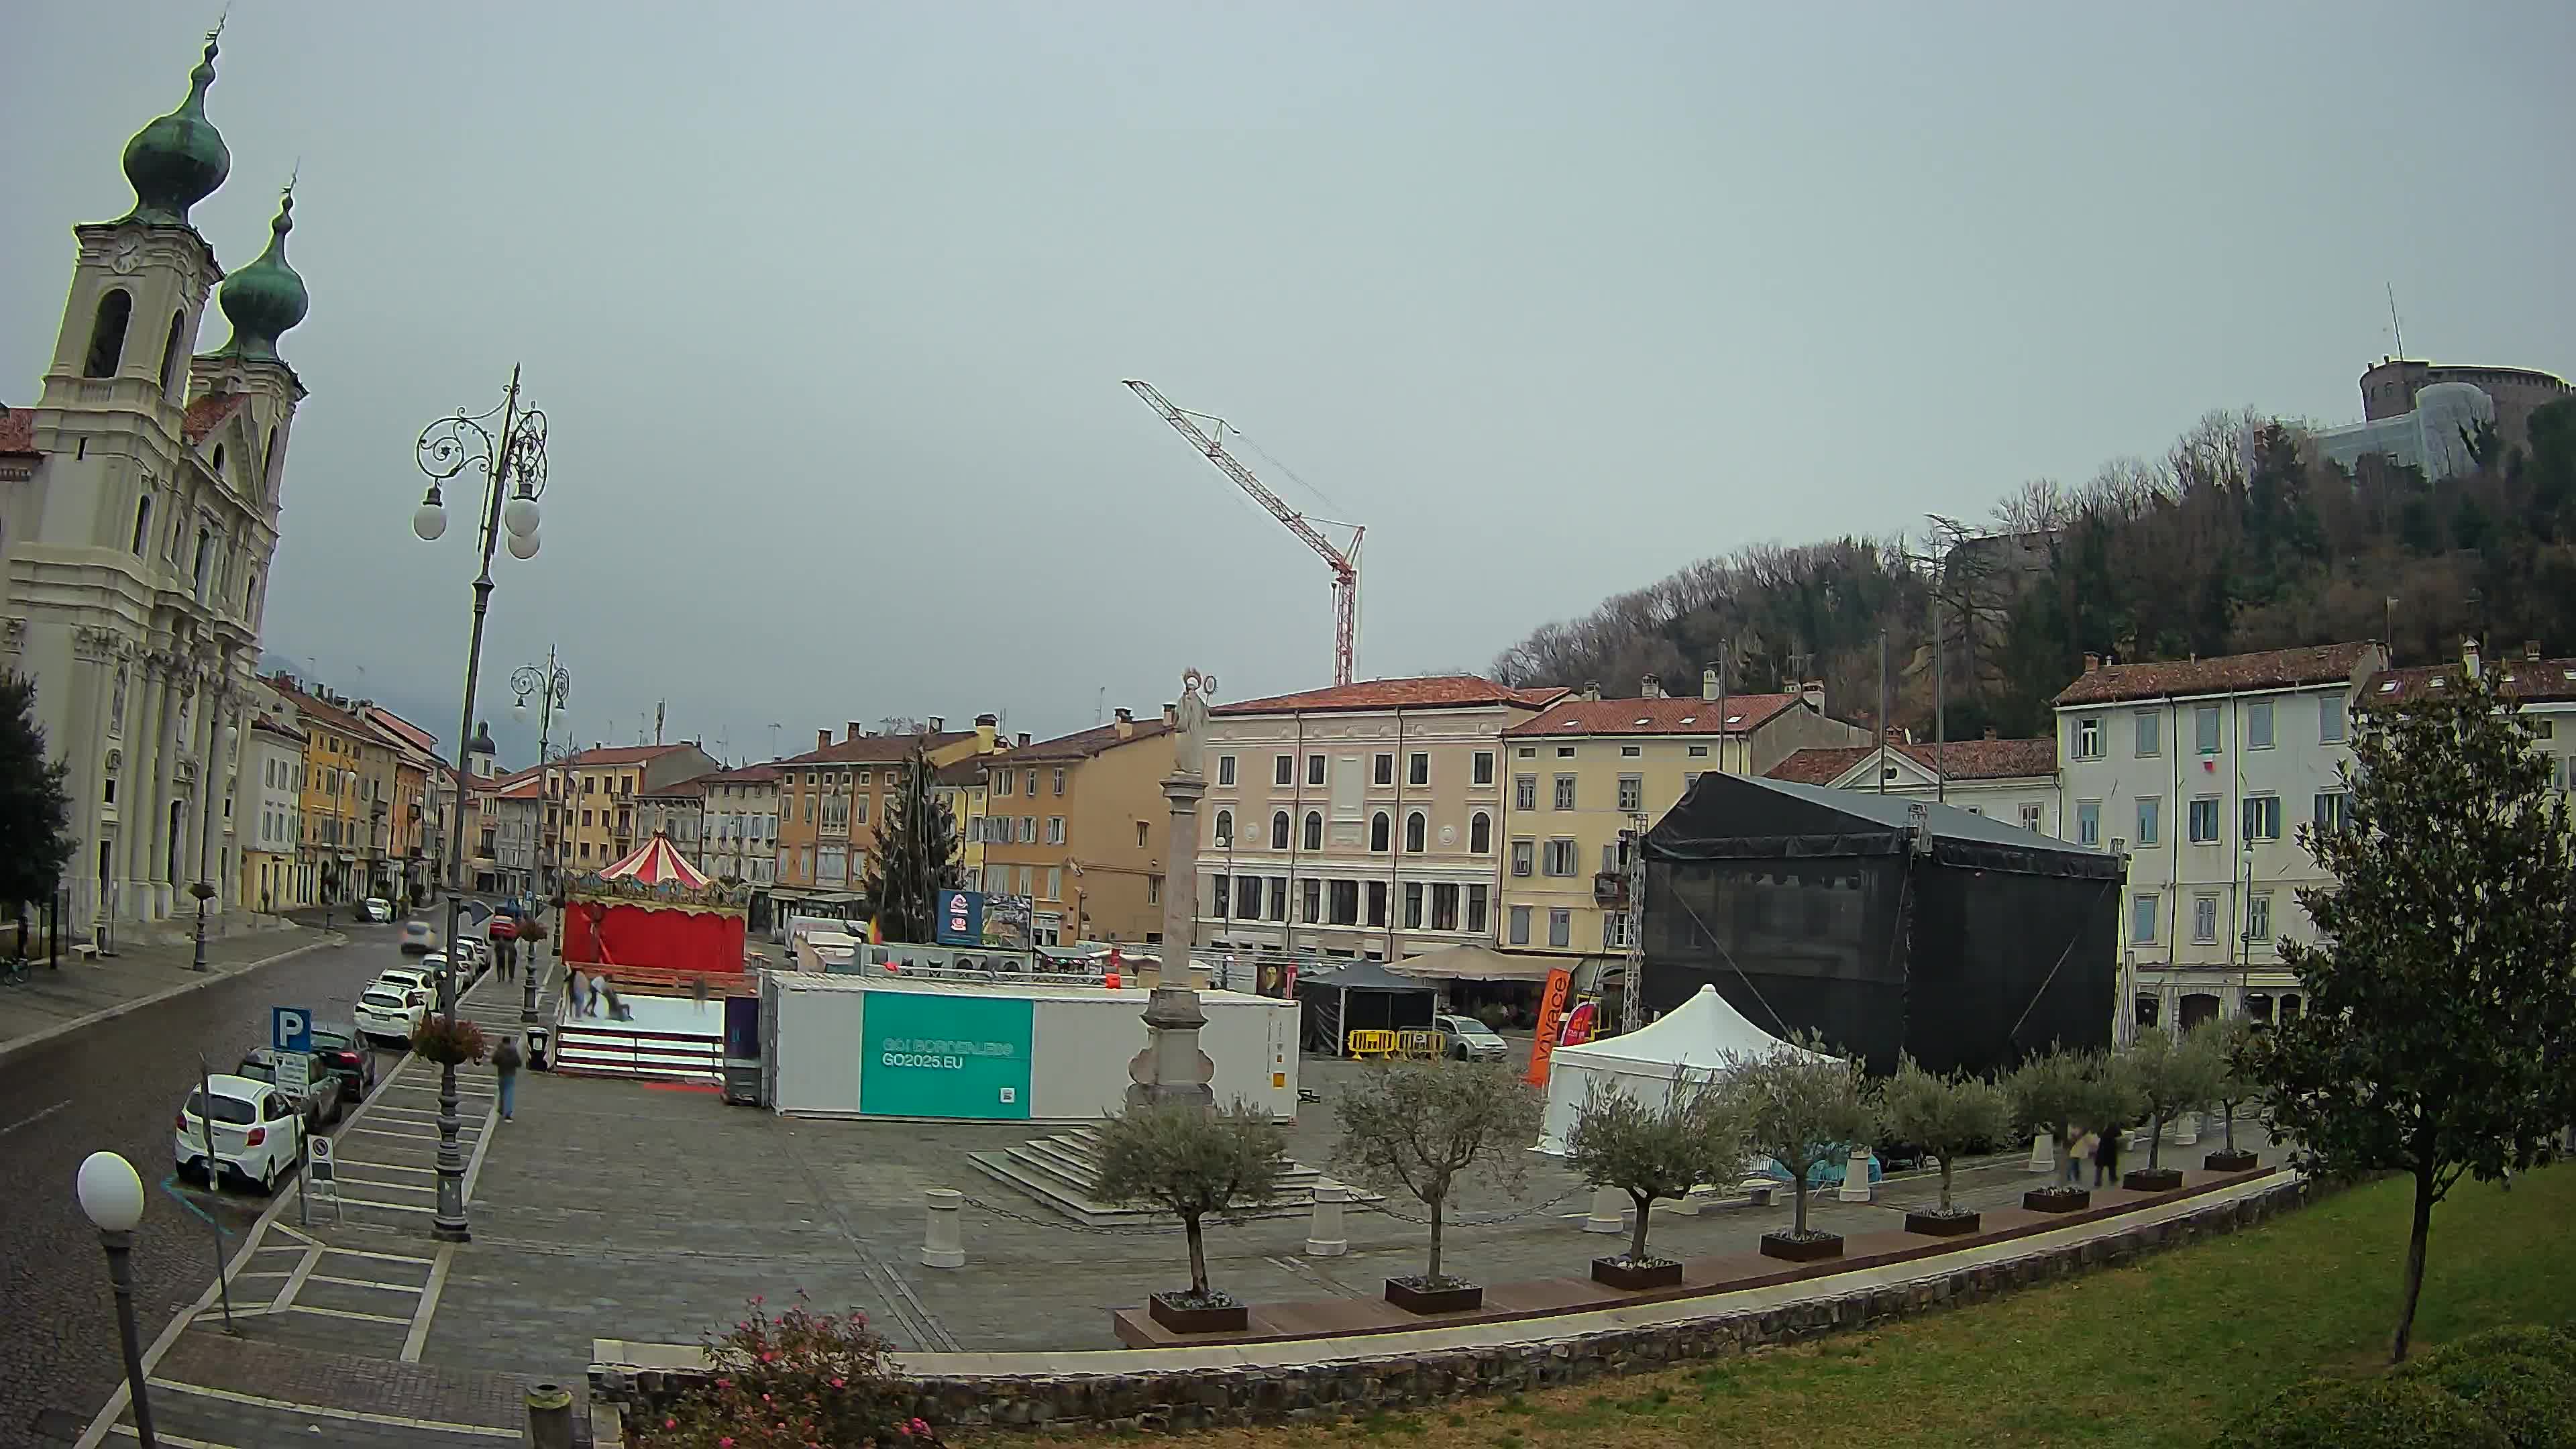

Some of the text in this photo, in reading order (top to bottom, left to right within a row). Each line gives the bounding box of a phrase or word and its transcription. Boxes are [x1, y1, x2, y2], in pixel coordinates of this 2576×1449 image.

[279, 1010, 304, 1047] P
[1534, 977, 1567, 1061] vivace
[882, 1053, 963, 1069] GO2025.EU
